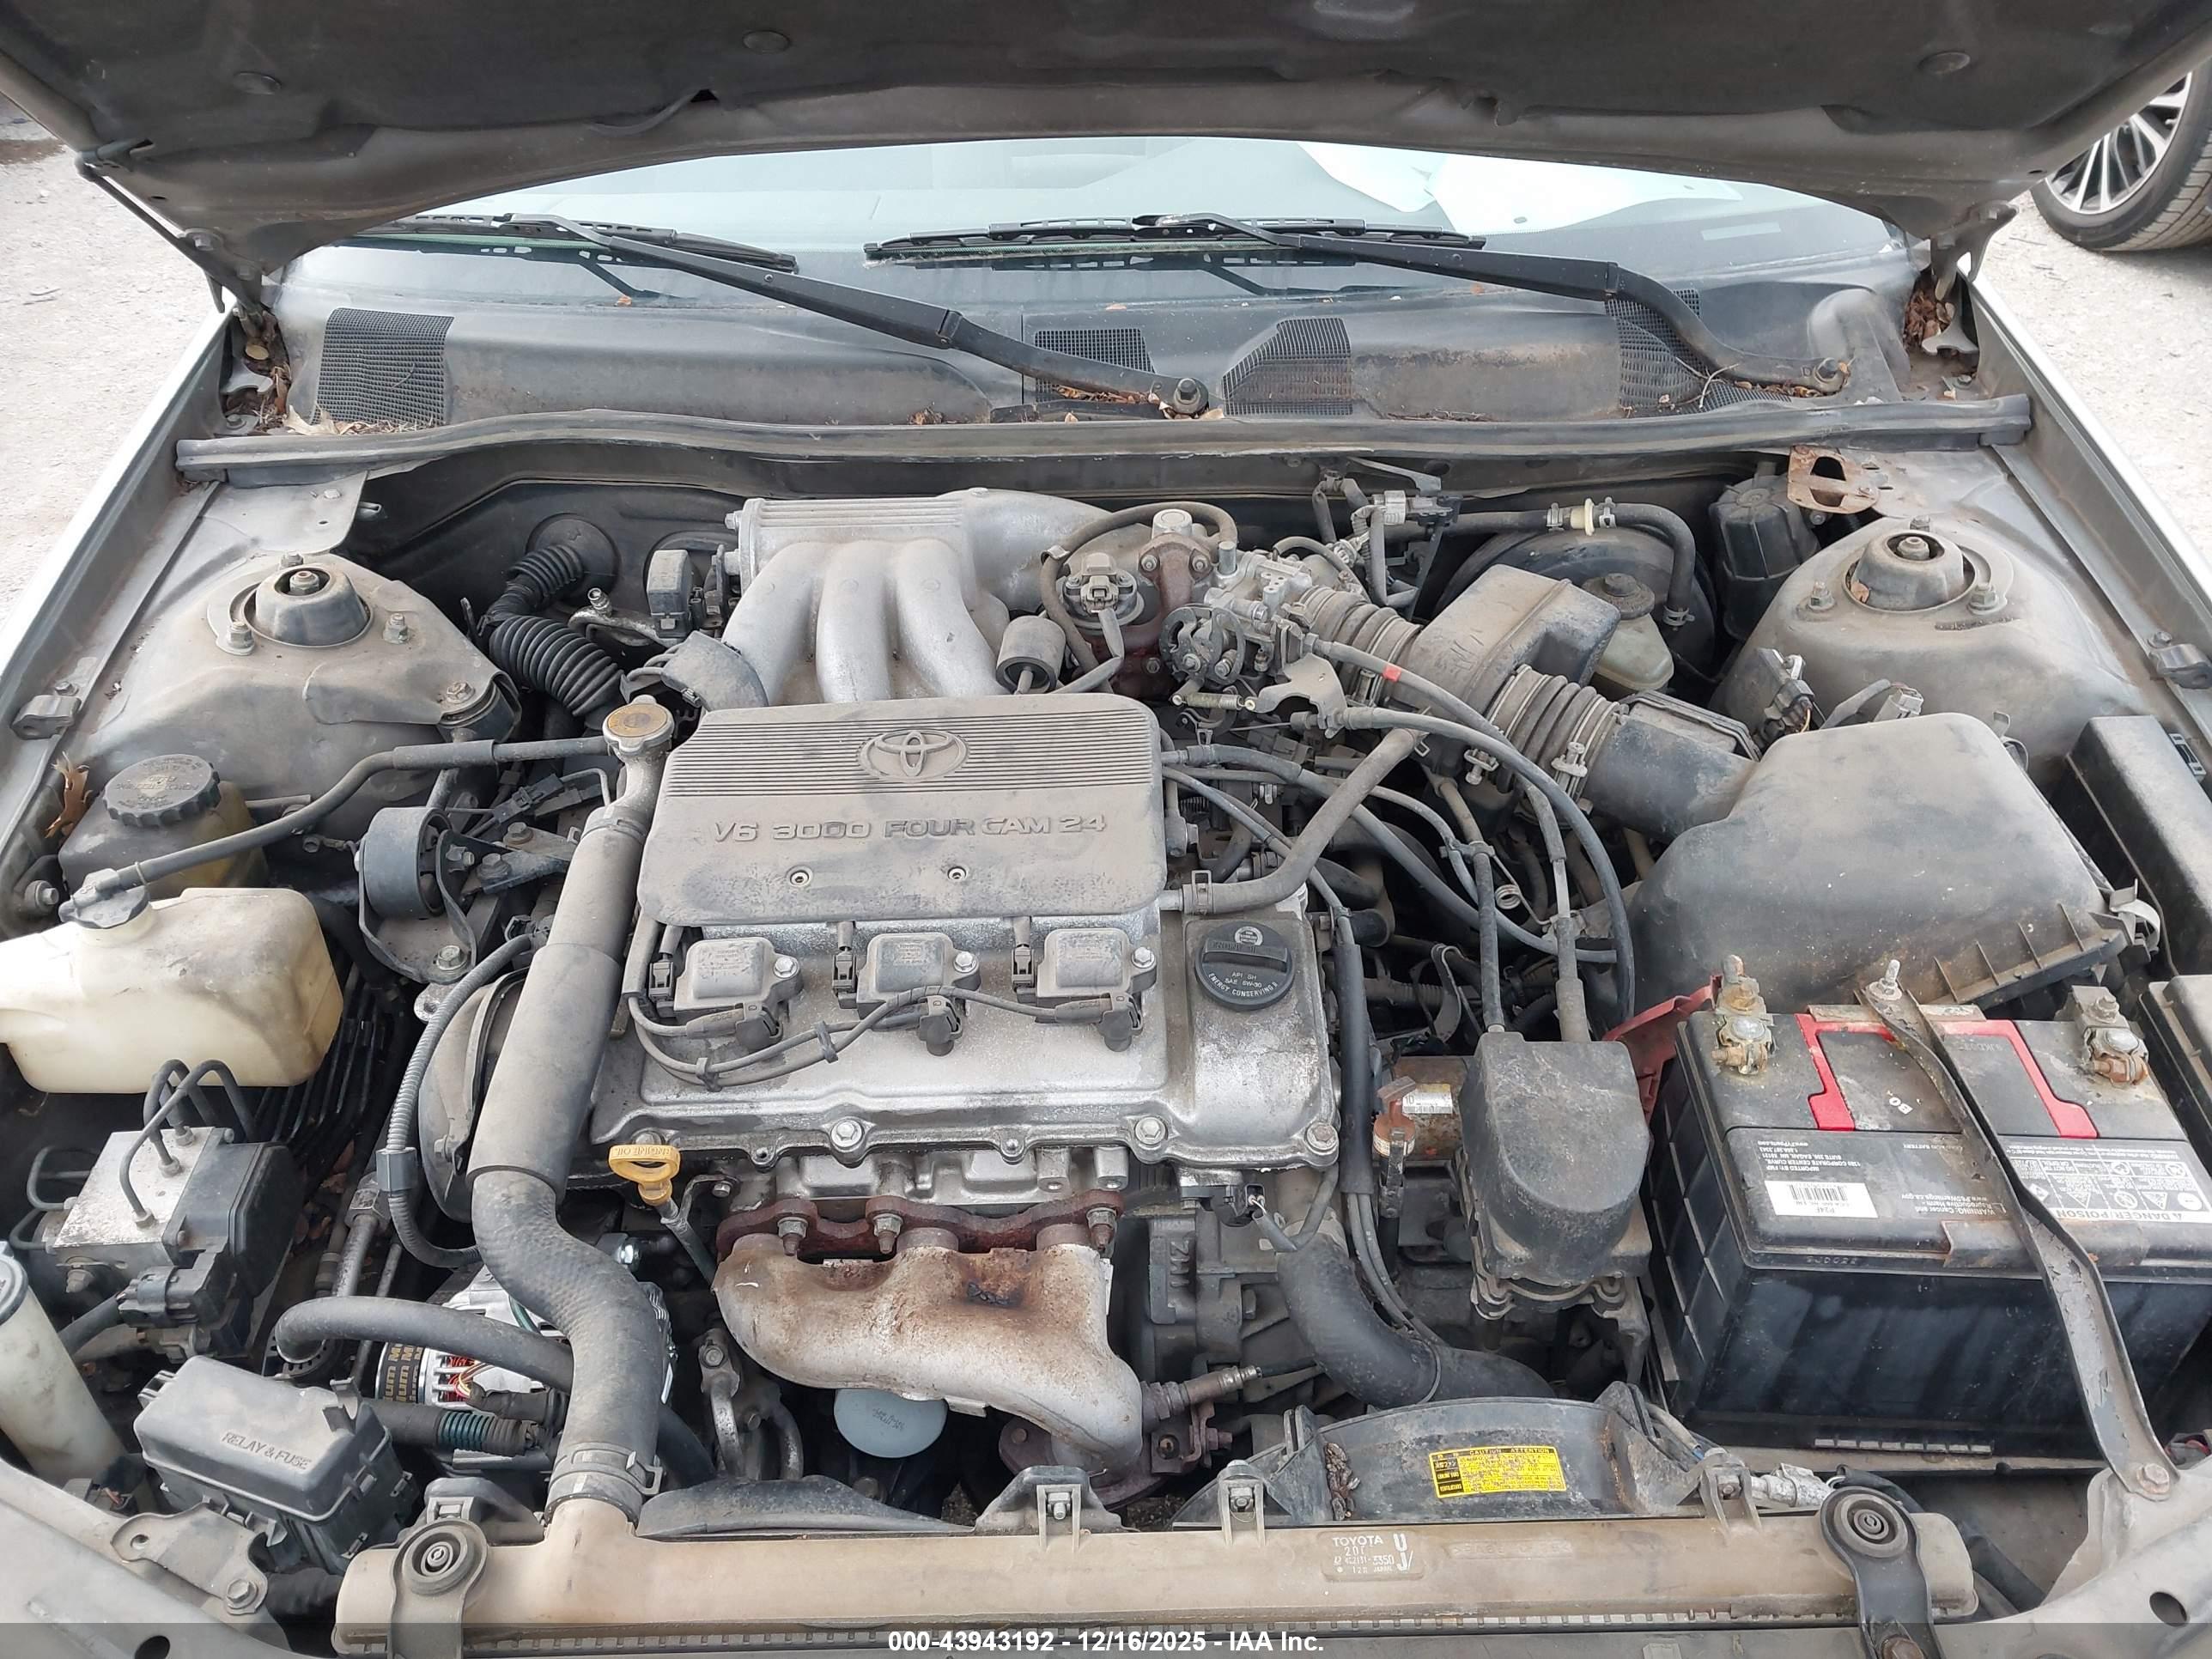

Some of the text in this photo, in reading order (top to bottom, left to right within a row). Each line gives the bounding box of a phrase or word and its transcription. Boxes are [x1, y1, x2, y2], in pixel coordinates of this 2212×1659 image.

[714, 813, 1107, 842] V6 3000 FOUR CAM 24
[1208, 973, 1231, 991] ENERGY
[1231, 984, 1275, 997] CONSERVING
[222, 1431, 313, 1470] RELAY & FUSE
[1332, 1534, 1384, 1547] TOYOTA
